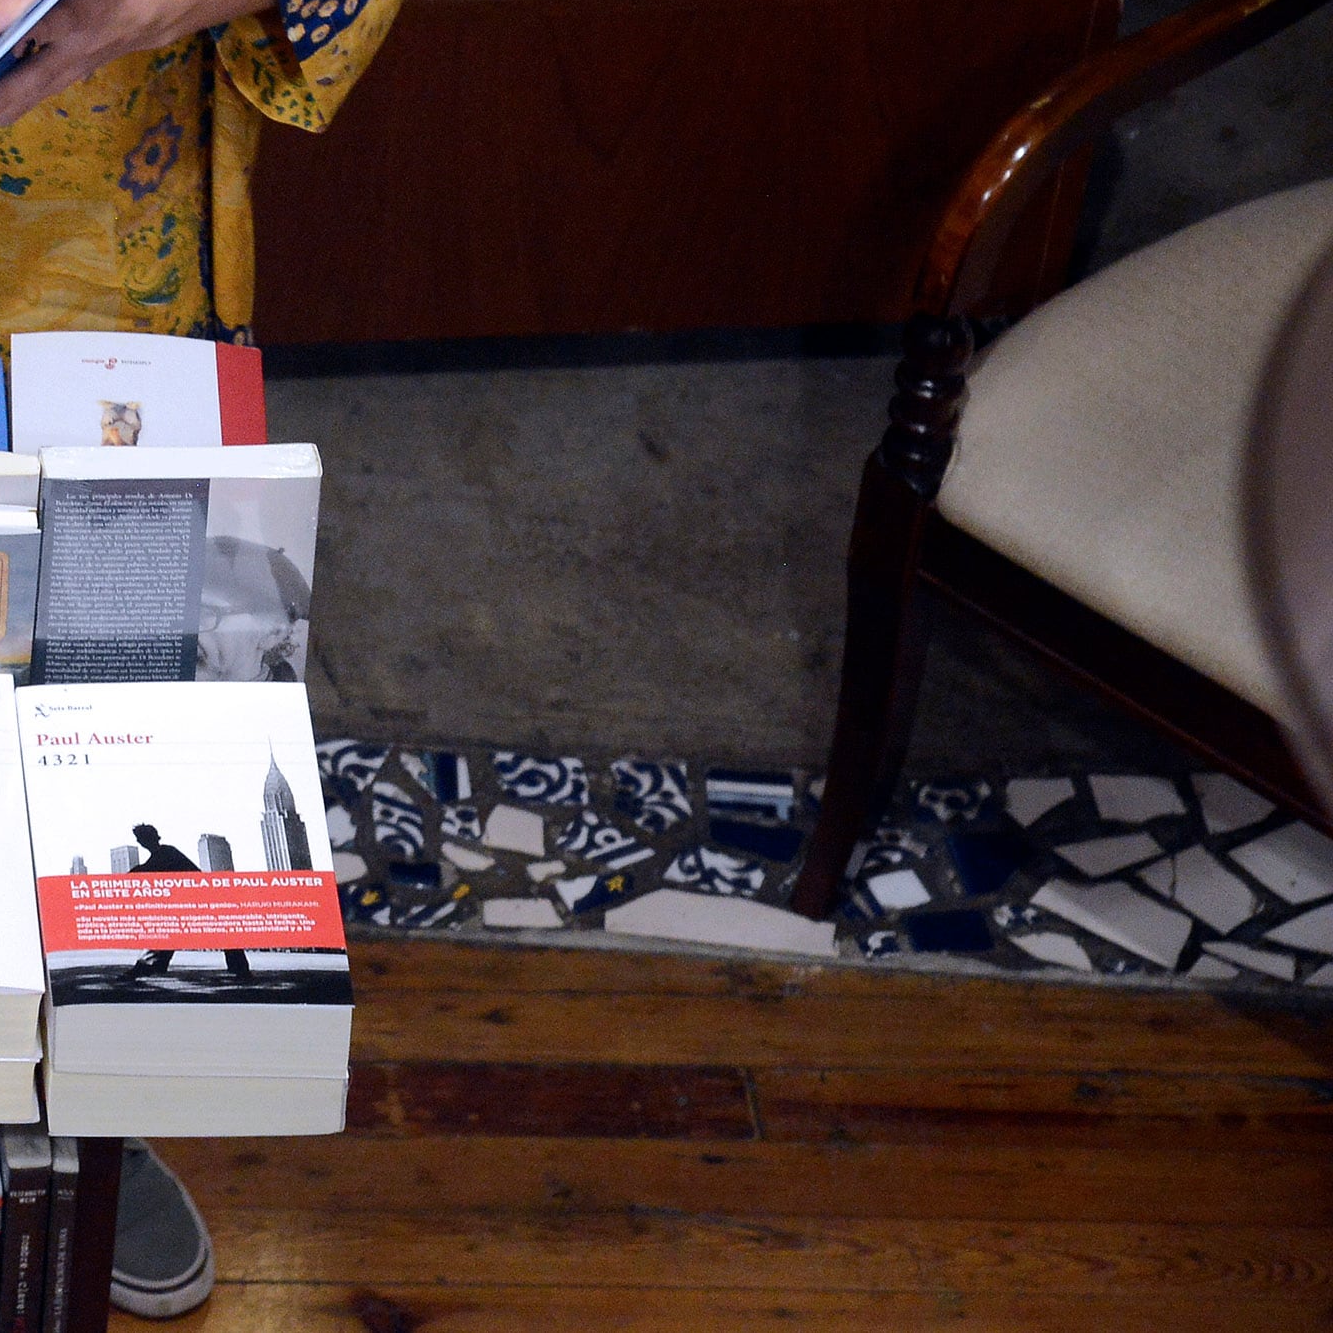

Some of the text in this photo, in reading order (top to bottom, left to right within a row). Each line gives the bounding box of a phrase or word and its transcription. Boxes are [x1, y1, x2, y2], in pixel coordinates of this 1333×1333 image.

[37, 732, 153, 746] Paul Auster
[70, 877, 323, 890] LA PRIMERA NOVELA DE PAUL AUSTER
[93, 887, 171, 898] SIETE AÑOS
[135, 902, 197, 910] definitivamente
